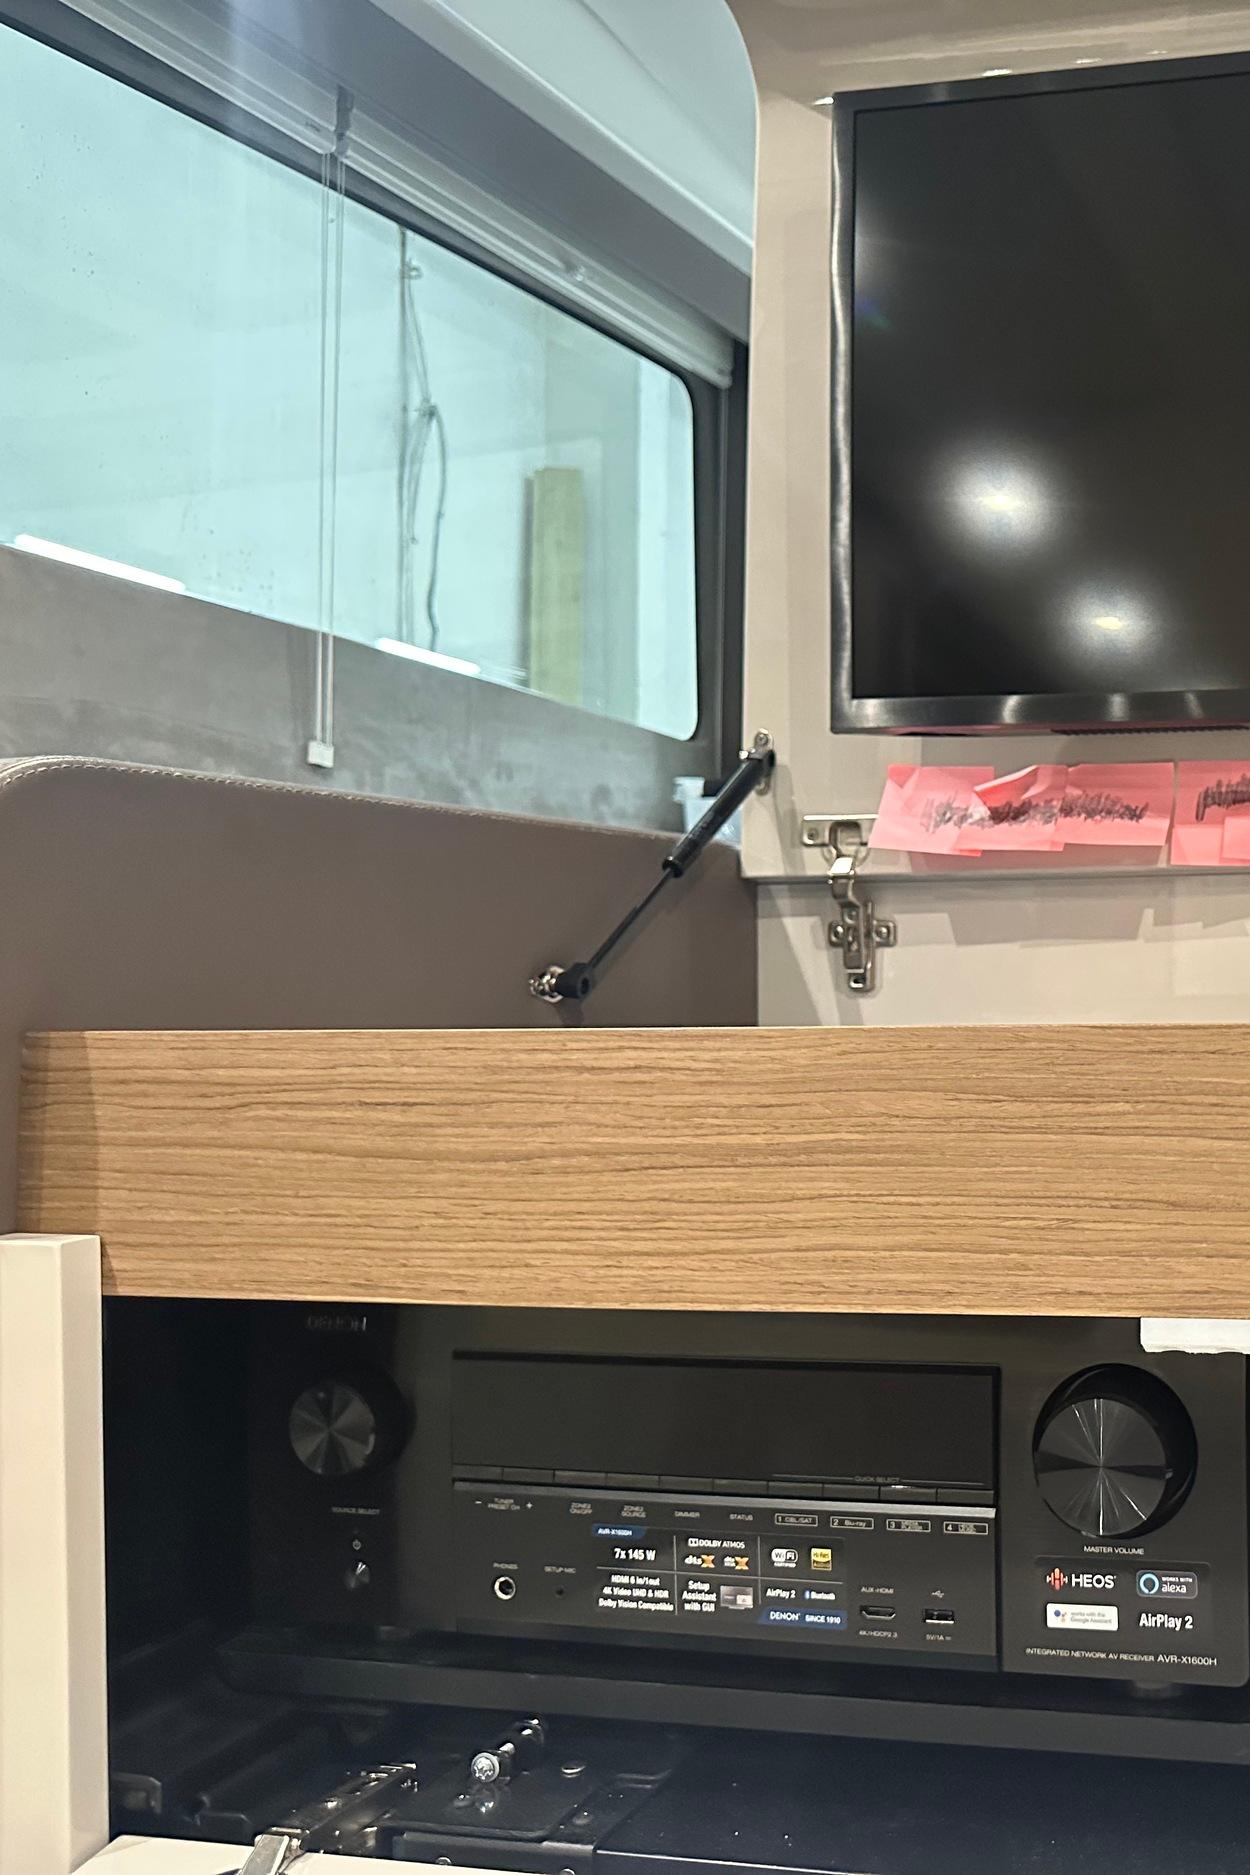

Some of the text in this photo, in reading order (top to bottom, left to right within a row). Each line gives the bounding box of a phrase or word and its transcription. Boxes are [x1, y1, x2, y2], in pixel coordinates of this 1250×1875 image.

[833, 1518, 840, 1527] 2
[699, 1539, 746, 1550] DOLBY ATMOS
[627, 1548, 645, 1561] 145
[645, 1549, 657, 1561] W
[1083, 1545, 1146, 1556] MASTER VOLUME
[687, 1580, 711, 1592] Setup
[1071, 1573, 1116, 1589] HEOS
[602, 1586, 613, 1595] 4K
[613, 1586, 632, 1597] Video
[765, 1588, 797, 1600] AirPlay 2
[1161, 1583, 1187, 1594] alexa
[682, 1591, 717, 1602] Assistant
[684, 1602, 716, 1612] with GUI
[769, 1610, 842, 1625] DENON SINCE 1910
[1139, 1611, 1194, 1631] AirPlay 2
[1026, 1648, 1218, 1667] INTEGRATED NETWORK AV RECEIVER AVR-X1600H
